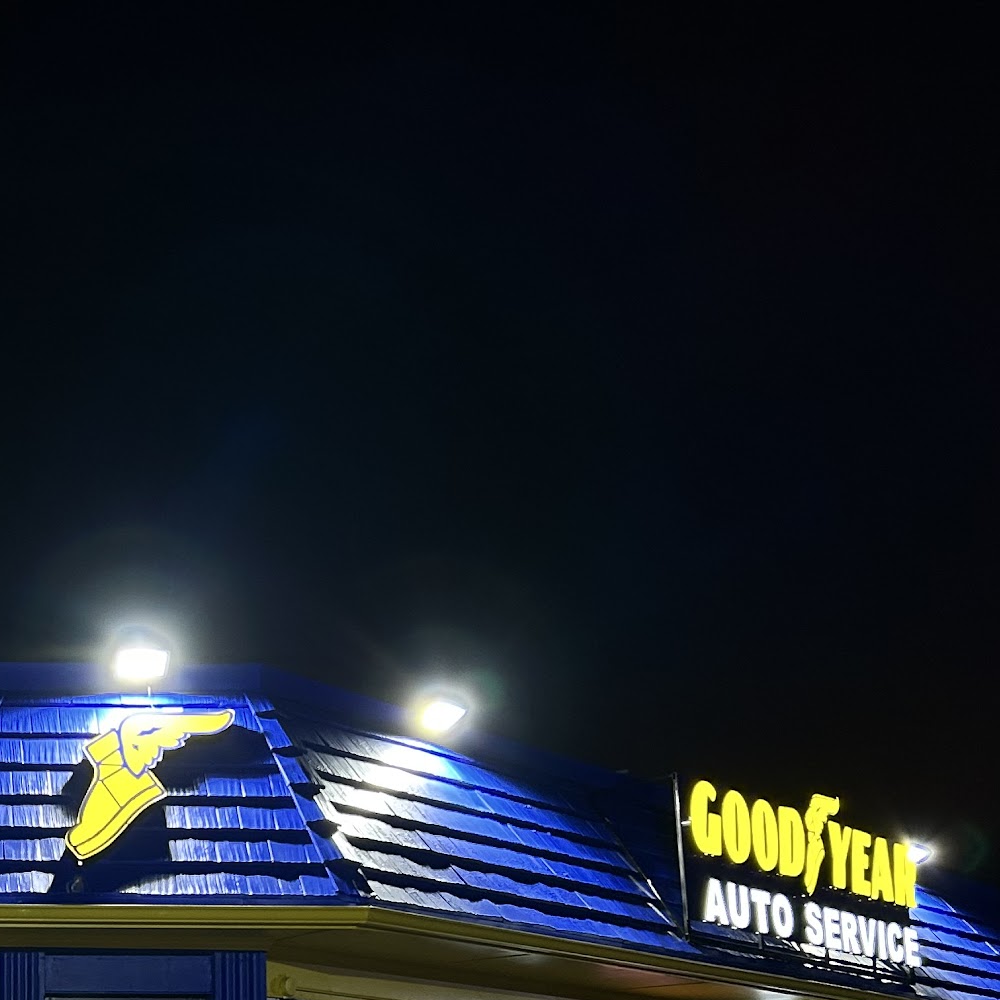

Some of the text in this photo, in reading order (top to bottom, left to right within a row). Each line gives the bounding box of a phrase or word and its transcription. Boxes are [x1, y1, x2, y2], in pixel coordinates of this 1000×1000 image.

[690, 780, 917, 909] GOODYEAR
[703, 877, 922, 968] AUTO SERVICE
